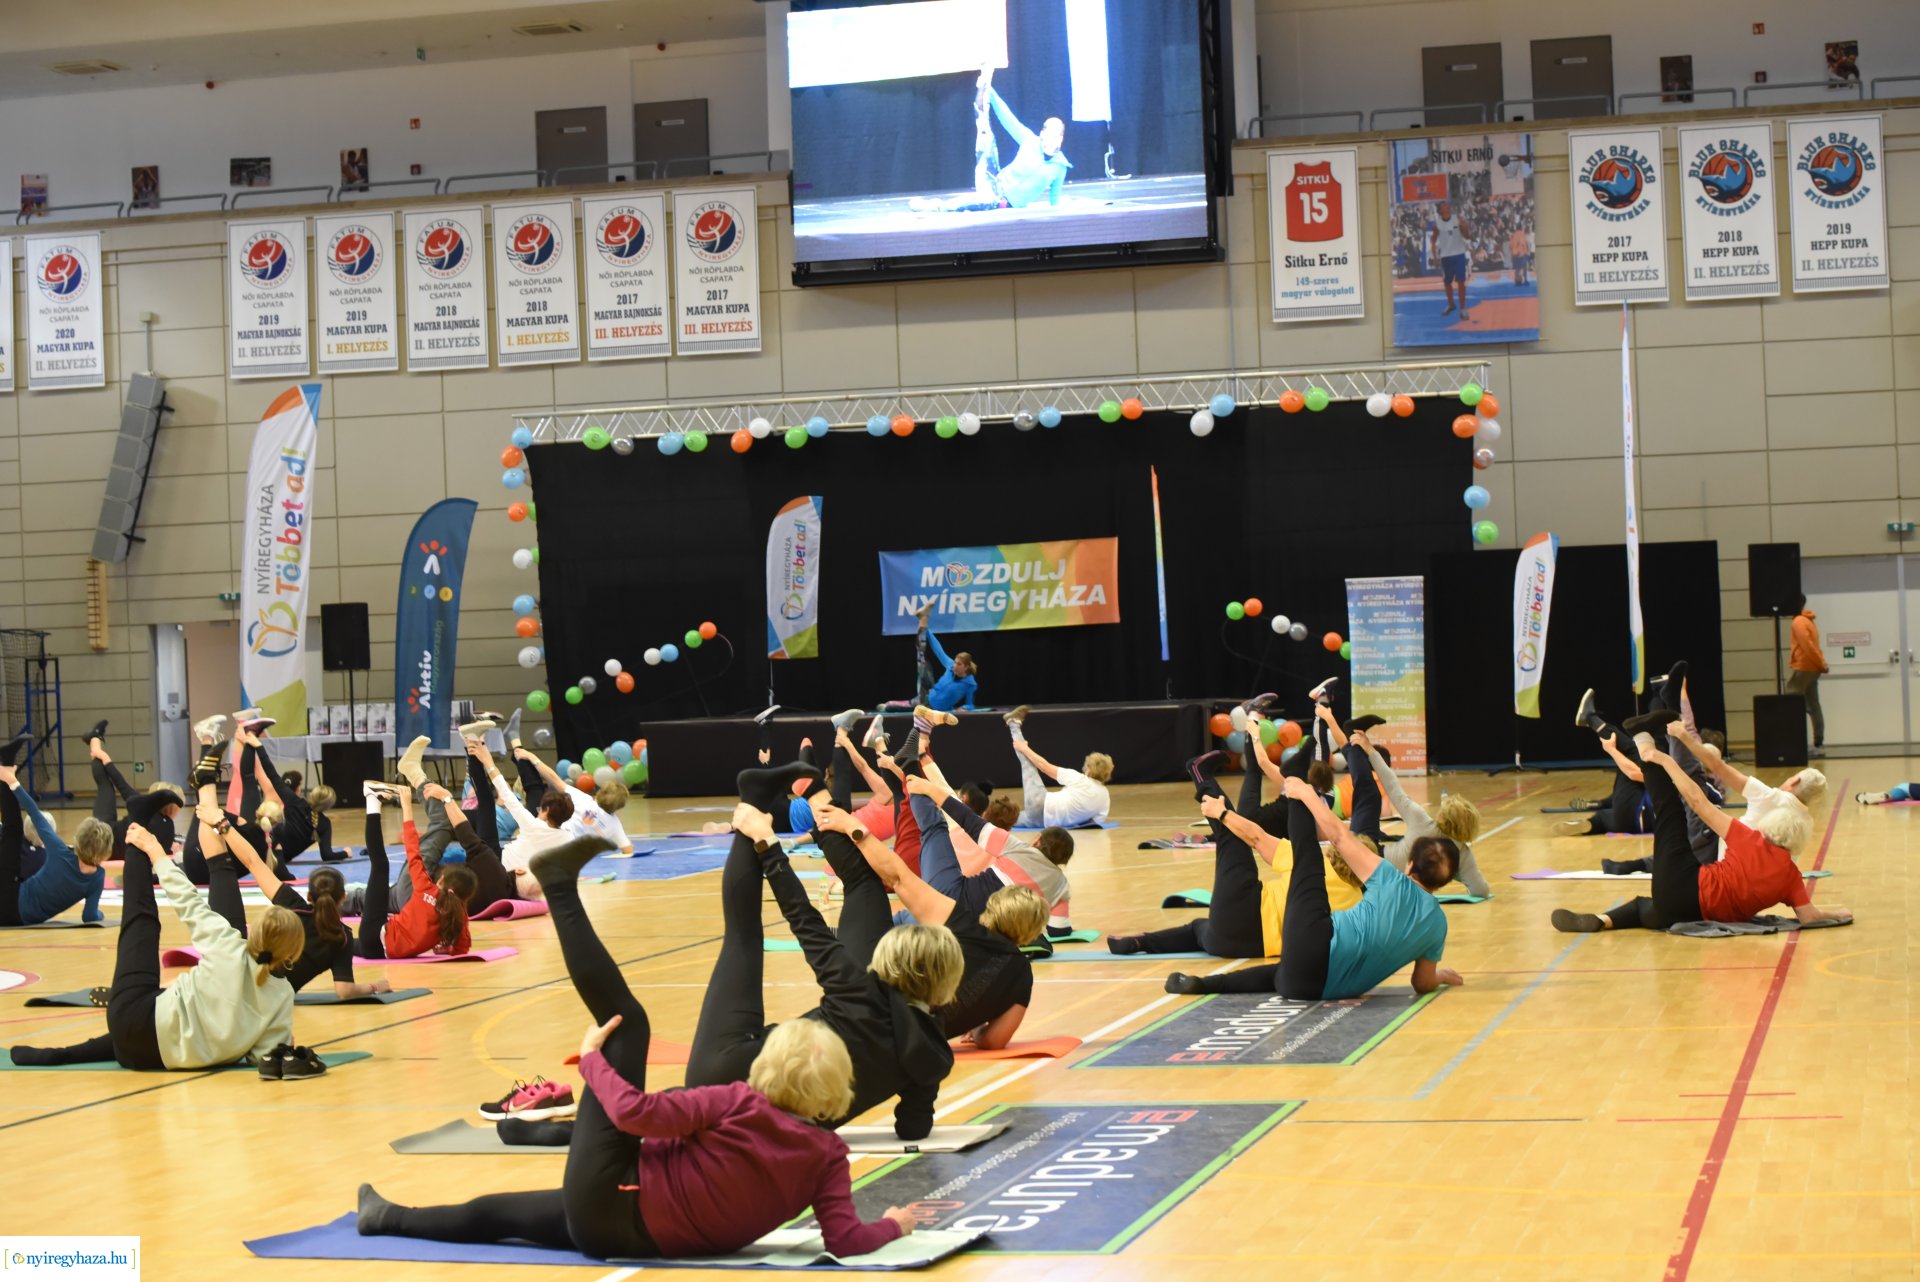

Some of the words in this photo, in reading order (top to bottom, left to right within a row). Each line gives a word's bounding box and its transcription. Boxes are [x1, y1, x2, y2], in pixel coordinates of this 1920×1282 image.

[1432, 150, 1462, 164] SITKU
[1688, 143, 1716, 178] BLUE
[1720, 139, 1766, 178] SHARKS
[1797, 136, 1825, 171] BLUE
[1829, 132, 1876, 171] SHARKS
[1579, 149, 1606, 183] BLUE
[1610, 145, 1656, 184] SHARKS
[1296, 175, 1330, 186] SITKU
[690, 204, 726, 226] FATUM
[1300, 191, 1328, 224] 15
[600, 208, 634, 230] FATUM
[420, 221, 454, 243] FATUM
[510, 216, 543, 239] FATUM
[1827, 223, 1851, 235] 2019
[1608, 236, 1632, 248] 2017
[1718, 231, 1742, 242] 2018
[1703, 248, 1729, 258] HEPP
[1732, 246, 1759, 256] KUPA
[1811, 241, 1838, 250] HEPP
[1841, 239, 1868, 249] KUPA
[1285, 254, 1316, 268] Sitku
[1319, 252, 1348, 266] Ernő
[1593, 253, 1619, 263] HEPP
[1622, 251, 1648, 261] KUPA
[1802, 260, 1814, 271] II.
[1818, 253, 1879, 270] HELYEZÉS
[1584, 272, 1597, 283] III.
[1599, 266, 1659, 282] HELYEZÉS
[1694, 268, 1706, 278] II.
[1710, 260, 1770, 277] HELYEZÉS
[610, 280, 642, 288] CSAPATA
[430, 292, 462, 300] CSAPATA
[617, 294, 638, 305] 2017
[707, 290, 728, 300] 2017
[436, 306, 456, 317] 2018
[527, 301, 547, 312] 2018
[594, 311, 622, 320] MAGYAR
[624, 305, 661, 319] BAJNOKSÁG
[686, 305, 723, 316] MAGYAR
[726, 304, 750, 314] KUPA
[259, 315, 279, 325] 2019
[346, 310, 367, 321] 2019
[507, 316, 543, 327] MAGYAR
[546, 314, 568, 324] KUPA
[327, 326, 362, 336] MAGYAR
[365, 324, 387, 334] KUPA
[414, 322, 441, 331] MAGYAR
[443, 316, 480, 330] BAJNOKSÁG
[612, 322, 663, 338] HELYEZÉS
[701, 317, 752, 334] HELYEZÉS
[56, 328, 75, 339] 2020
[238, 330, 263, 340] MAGYAR
[265, 326, 301, 339] BAJNOKSÁG
[517, 330, 569, 345] HELYEZÉS
[37, 343, 72, 353] MAGYAR
[73, 341, 94, 351] KUPA
[336, 337, 388, 353] HELYEZÉS
[428, 333, 480, 349] HELYEZÉS
[251, 342, 301, 357] HELYEZÉS
[48, 355, 97, 370] HELYEZÉS
[257, 484, 274, 595] NYÍREGYHÁZA
[276, 498, 304, 596] Többet
[792, 544, 806, 591] Többet
[897, 584, 1106, 617] NYÍREGYHÁZA
